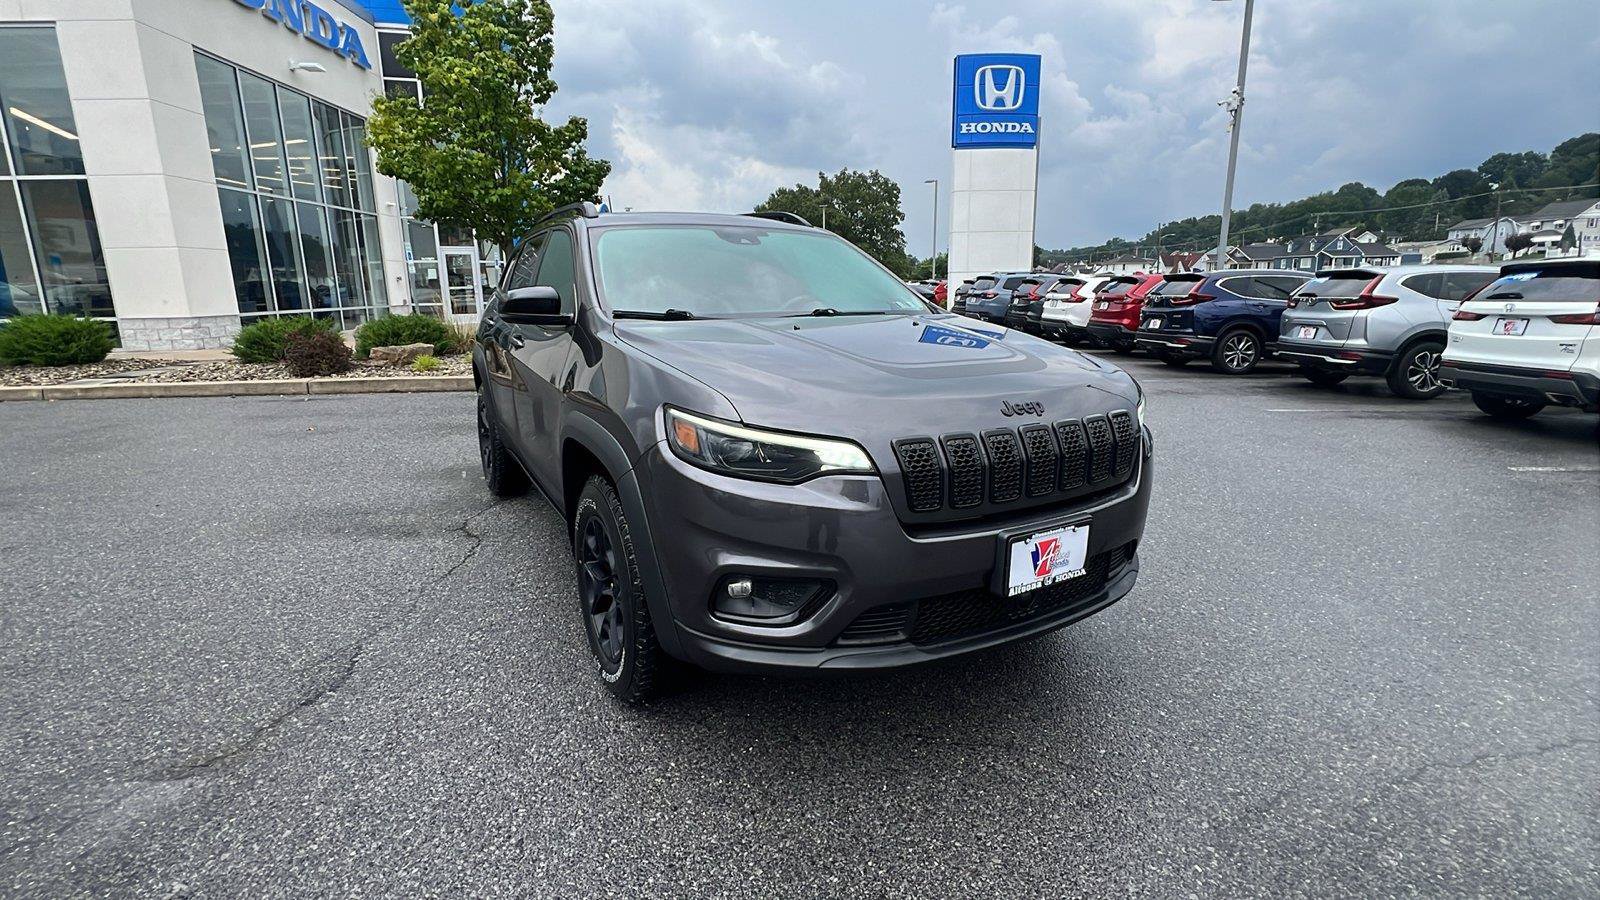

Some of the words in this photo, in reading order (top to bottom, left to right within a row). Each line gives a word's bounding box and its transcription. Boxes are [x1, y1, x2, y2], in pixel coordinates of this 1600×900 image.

[233, 0, 372, 70] NDA
[960, 122, 1035, 134] HONDA
[1000, 400, 1045, 417] Jeep
[1054, 568, 1087, 583] HONDA
